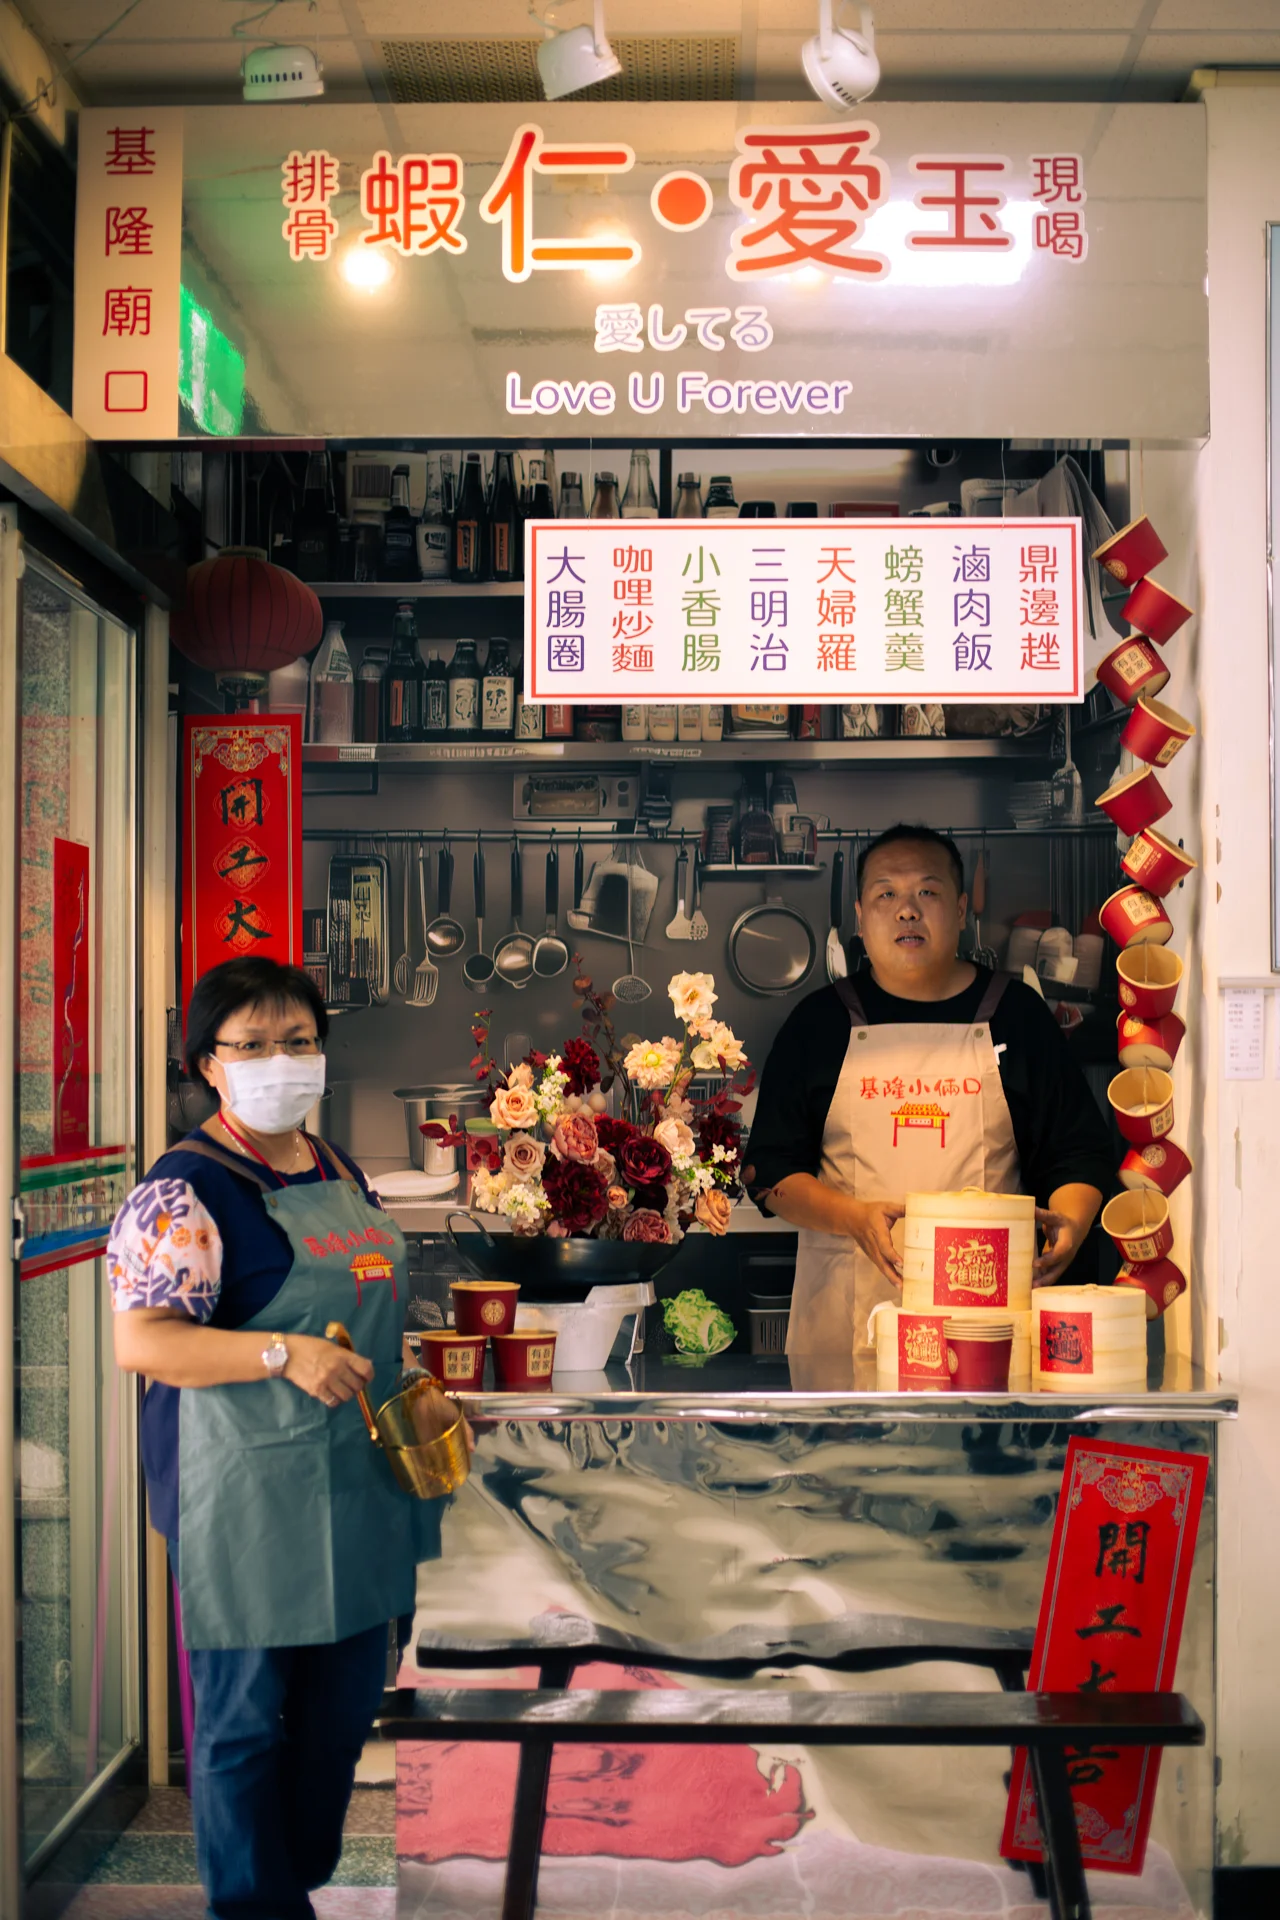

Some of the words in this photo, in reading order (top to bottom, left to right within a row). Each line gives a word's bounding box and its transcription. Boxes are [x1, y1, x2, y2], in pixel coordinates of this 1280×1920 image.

[284, 153, 337, 258] 排骨
[1031, 155, 1086, 260] 現喝
[102, 126, 156, 413] 基隆廟口
[598, 306, 771, 350] 愛してる
[508, 374, 612, 415] Love
[630, 375, 662, 414] U
[680, 376, 850, 415] Forever
[546, 545, 586, 673] 大腸圈
[612, 544, 655, 673] 咖哩炒麵
[681, 545, 722, 672] 小香腸
[749, 547, 789, 672] 三明治
[816, 546, 858, 672] 天婦羅
[884, 544, 925, 672] 螃蟹羹
[952, 544, 993, 672] 滷肉飯
[1018, 545, 1061, 671] 鼎邊趖
[859, 1075, 982, 1100] 基隆小倆口
